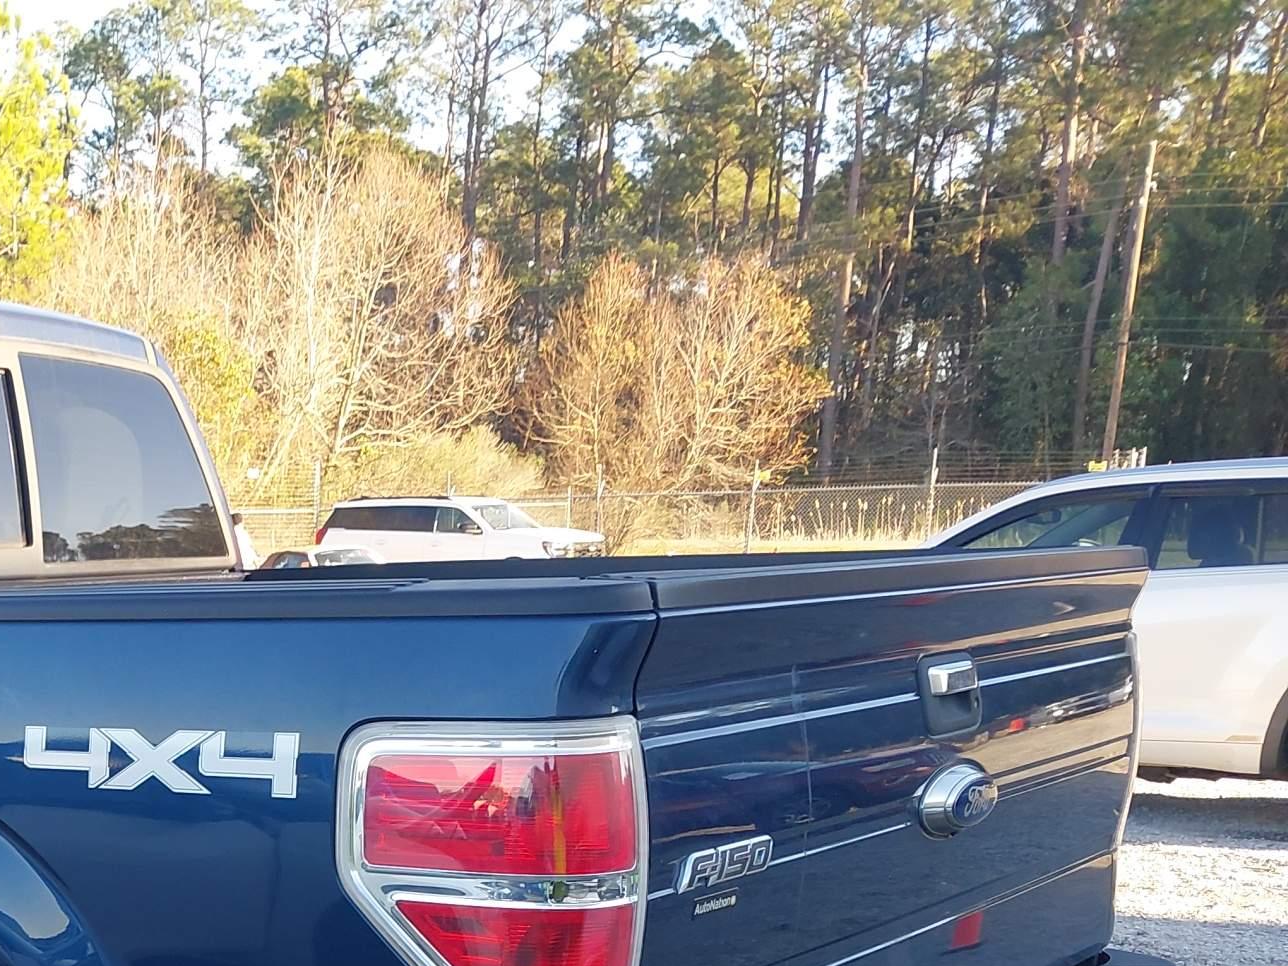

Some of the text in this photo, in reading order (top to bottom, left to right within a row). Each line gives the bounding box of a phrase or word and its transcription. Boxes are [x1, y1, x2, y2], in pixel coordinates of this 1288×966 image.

[962, 783, 997, 818] Ford
[678, 834, 773, 895] F-150
[694, 895, 732, 916] AutoNation
